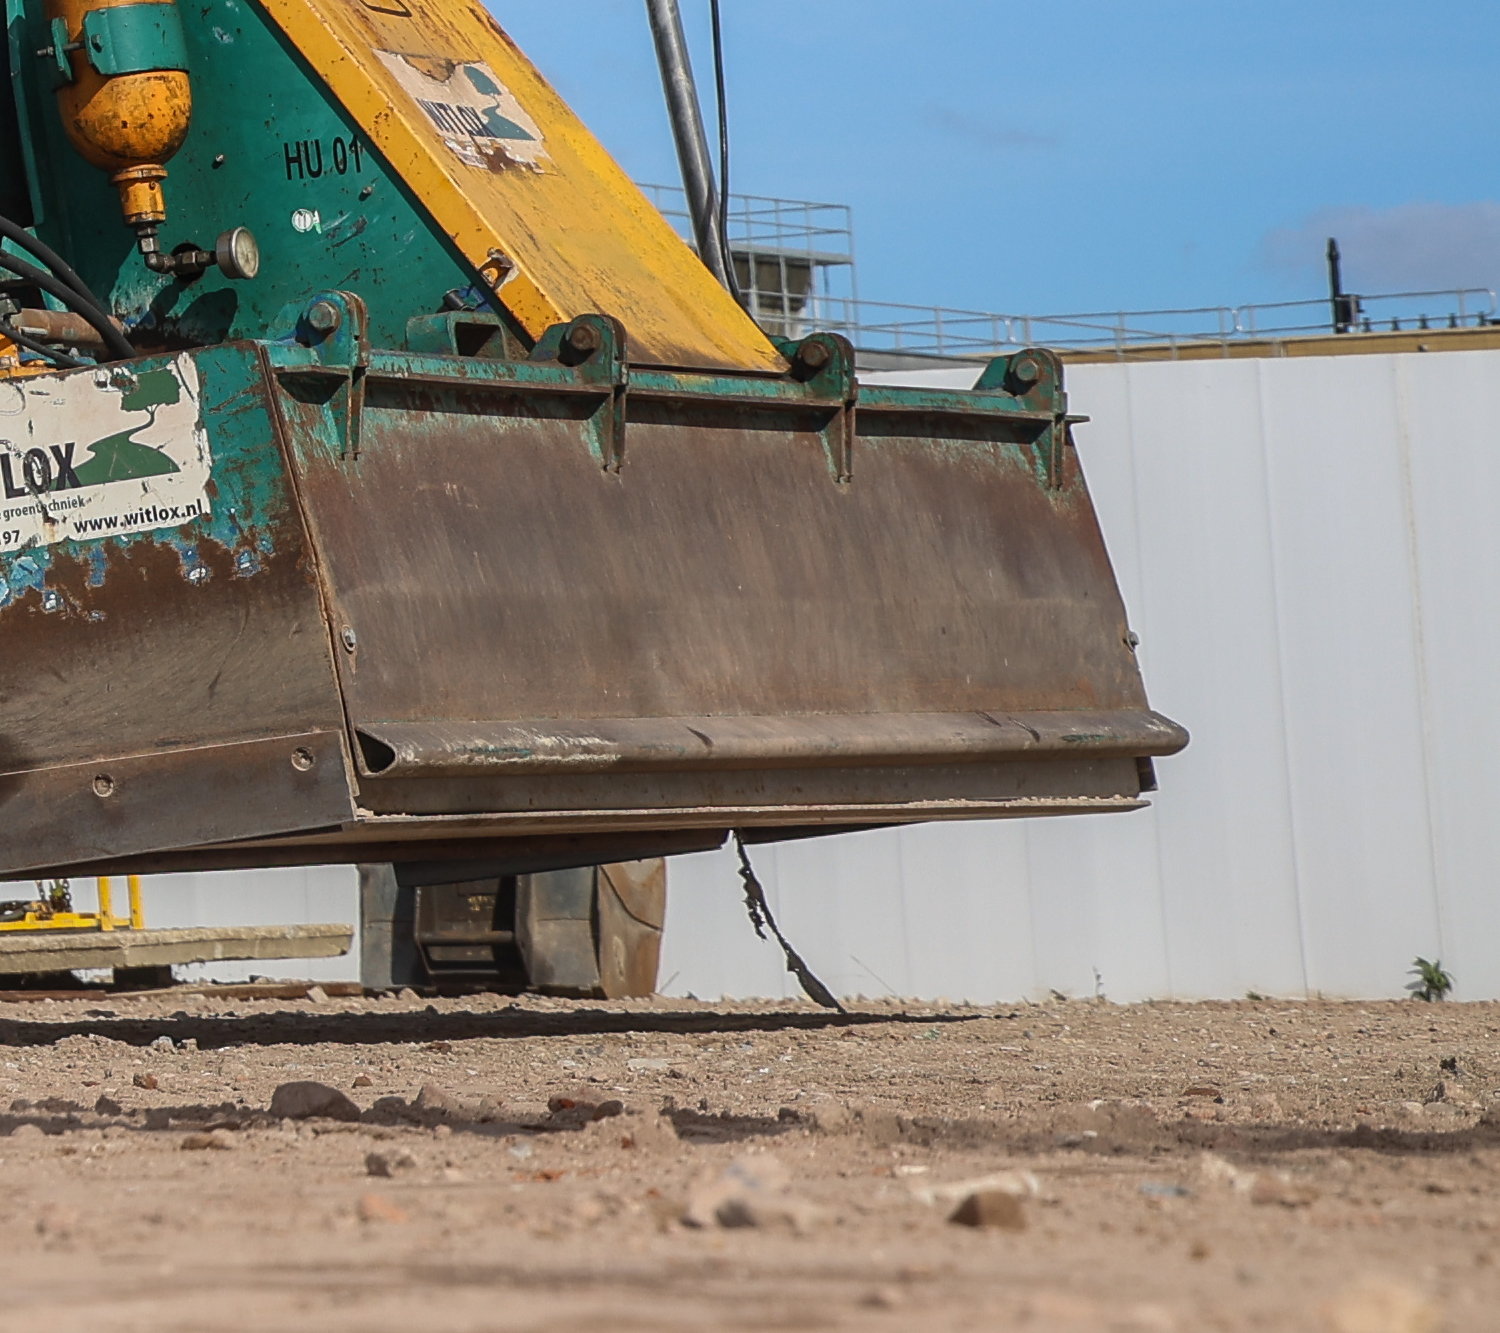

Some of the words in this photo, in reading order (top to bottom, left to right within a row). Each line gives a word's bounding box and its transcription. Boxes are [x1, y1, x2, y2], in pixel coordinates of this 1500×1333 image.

[284, 139, 323, 180] HU
[333, 134, 361, 175] 01
[73, 498, 202, 533] www.witlox.nl
